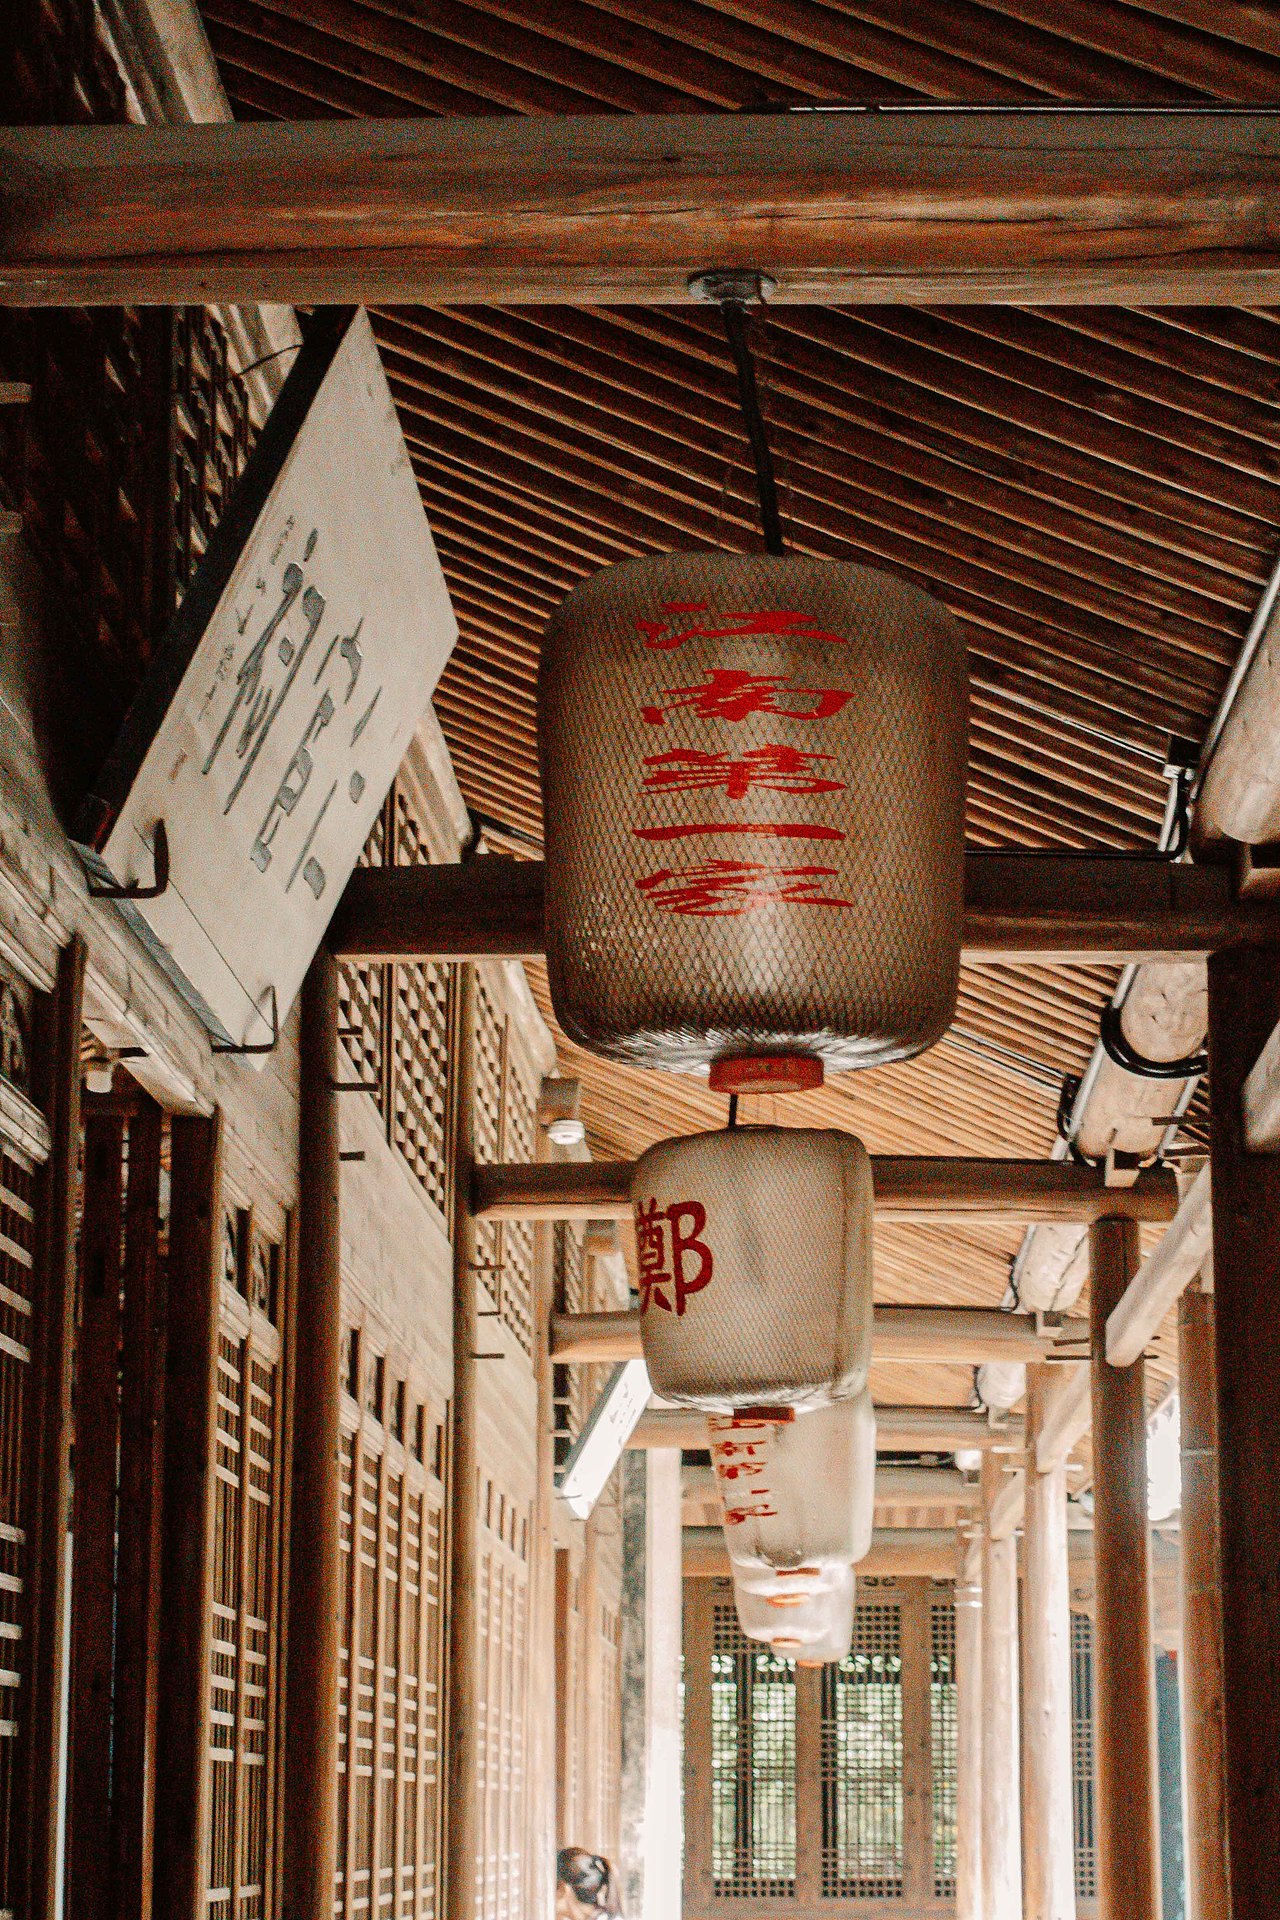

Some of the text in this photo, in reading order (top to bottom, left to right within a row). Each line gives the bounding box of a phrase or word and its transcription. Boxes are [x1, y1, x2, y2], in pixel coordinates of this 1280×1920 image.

[631, 601, 856, 917] 江南第一家
[637, 1197, 713, 1316] 鄭
